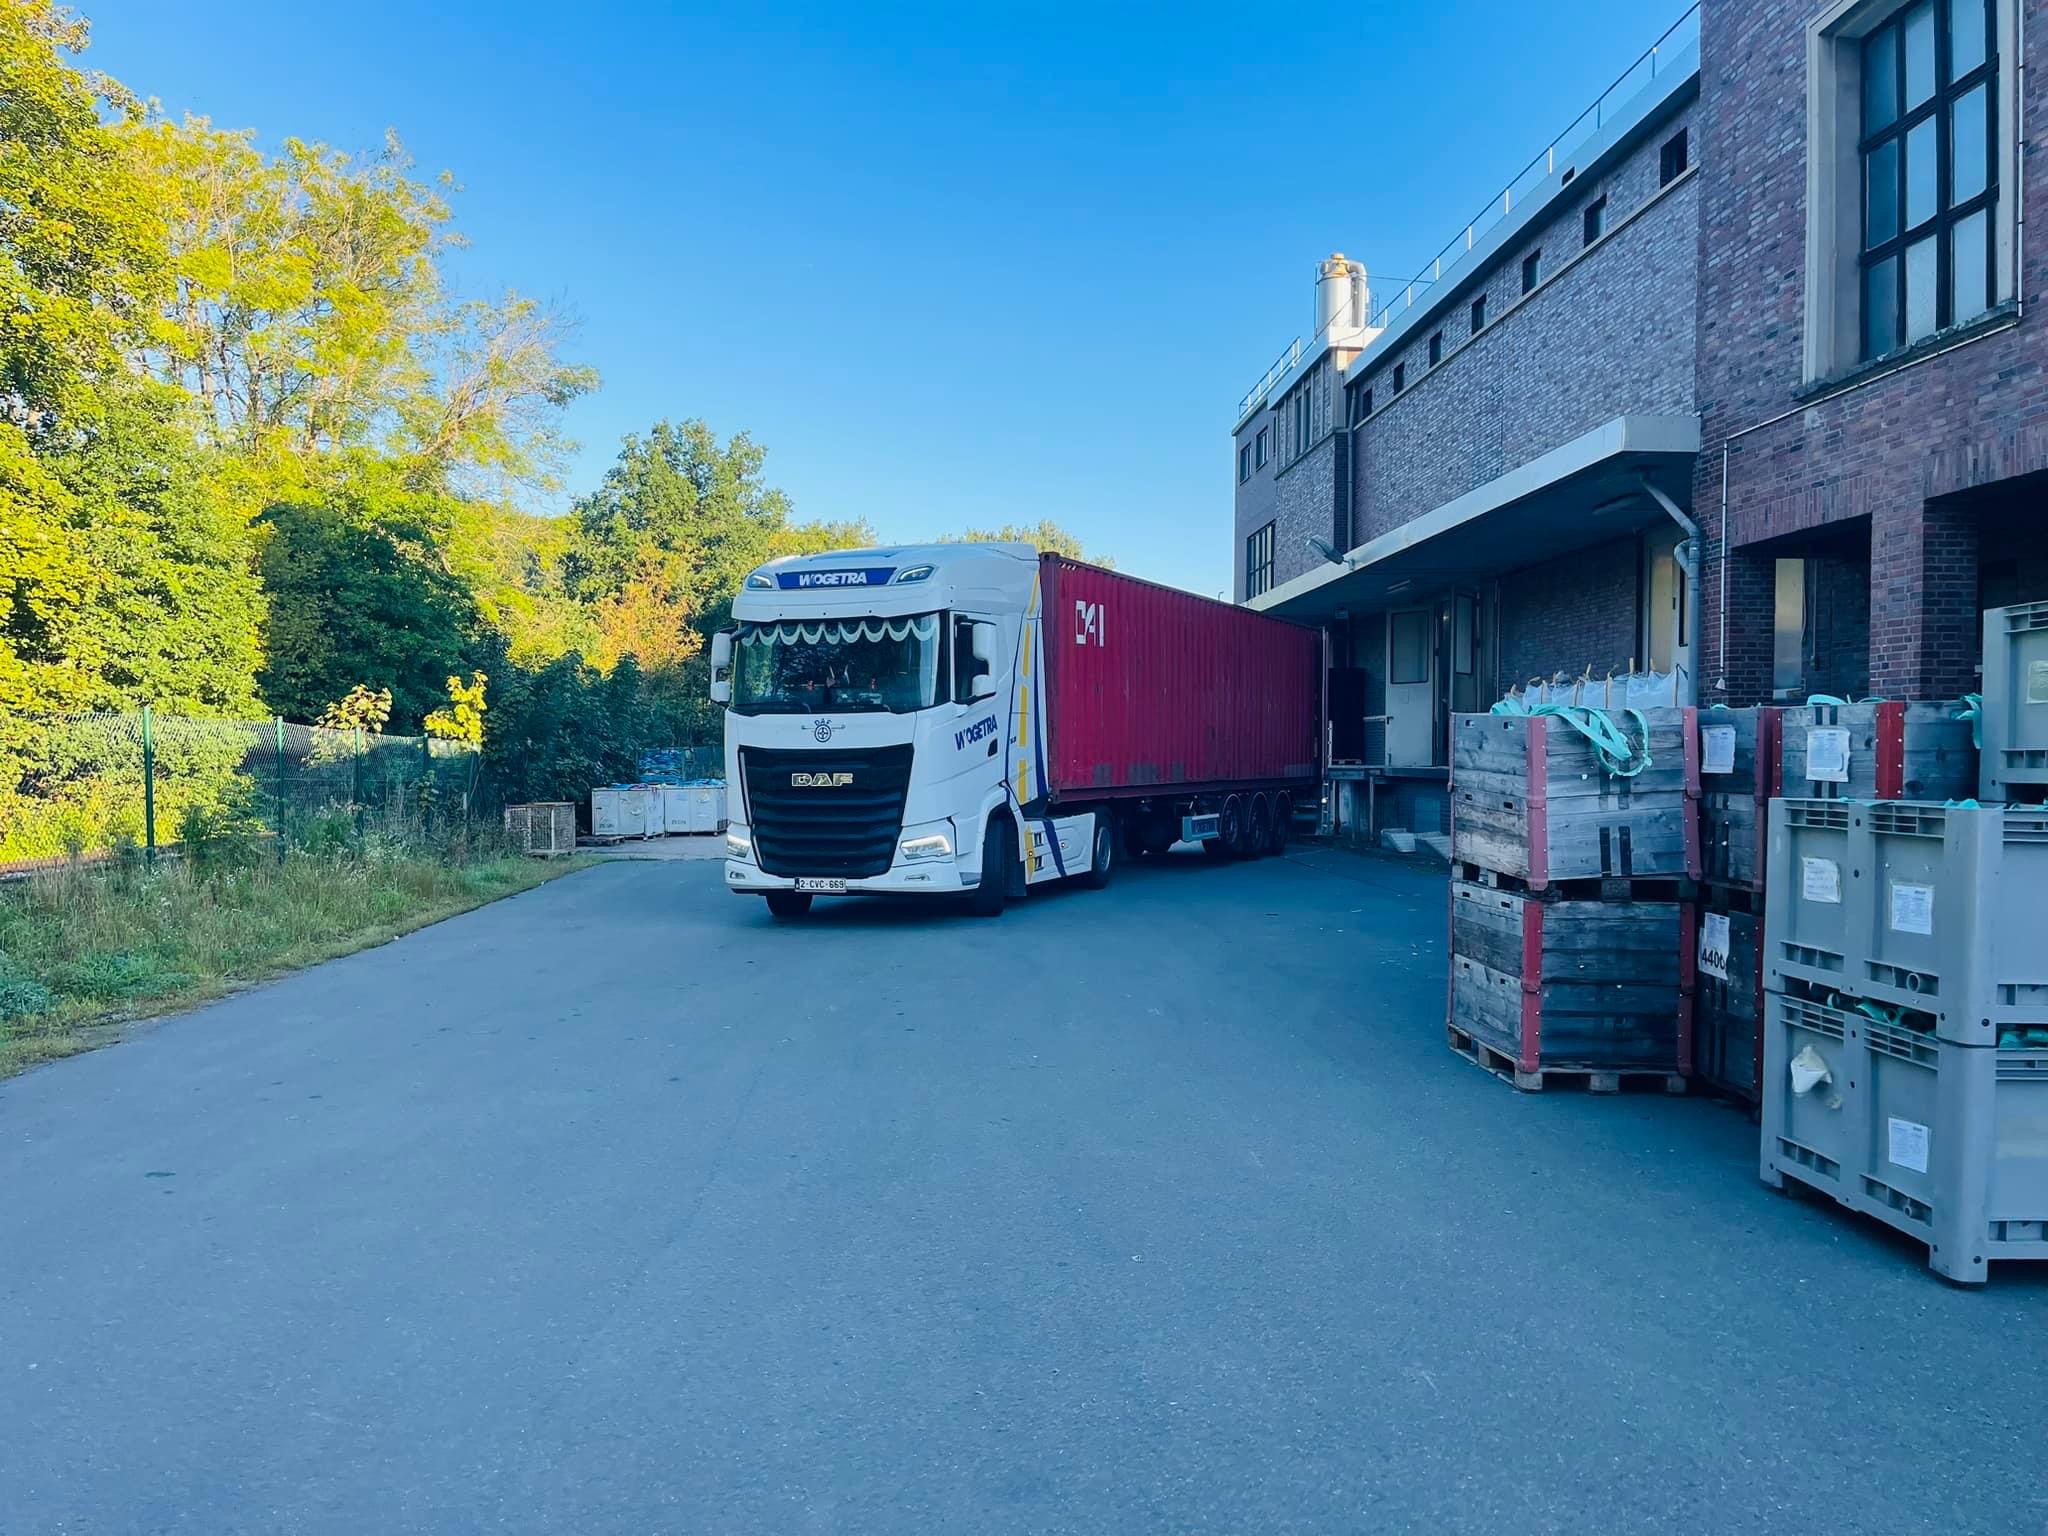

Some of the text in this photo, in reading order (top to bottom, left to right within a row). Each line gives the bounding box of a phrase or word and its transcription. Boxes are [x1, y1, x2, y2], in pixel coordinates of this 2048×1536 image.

[799, 572, 868, 586] WOGETRA
[954, 714, 998, 751] WOGETRA
[791, 773, 854, 787] DAF
